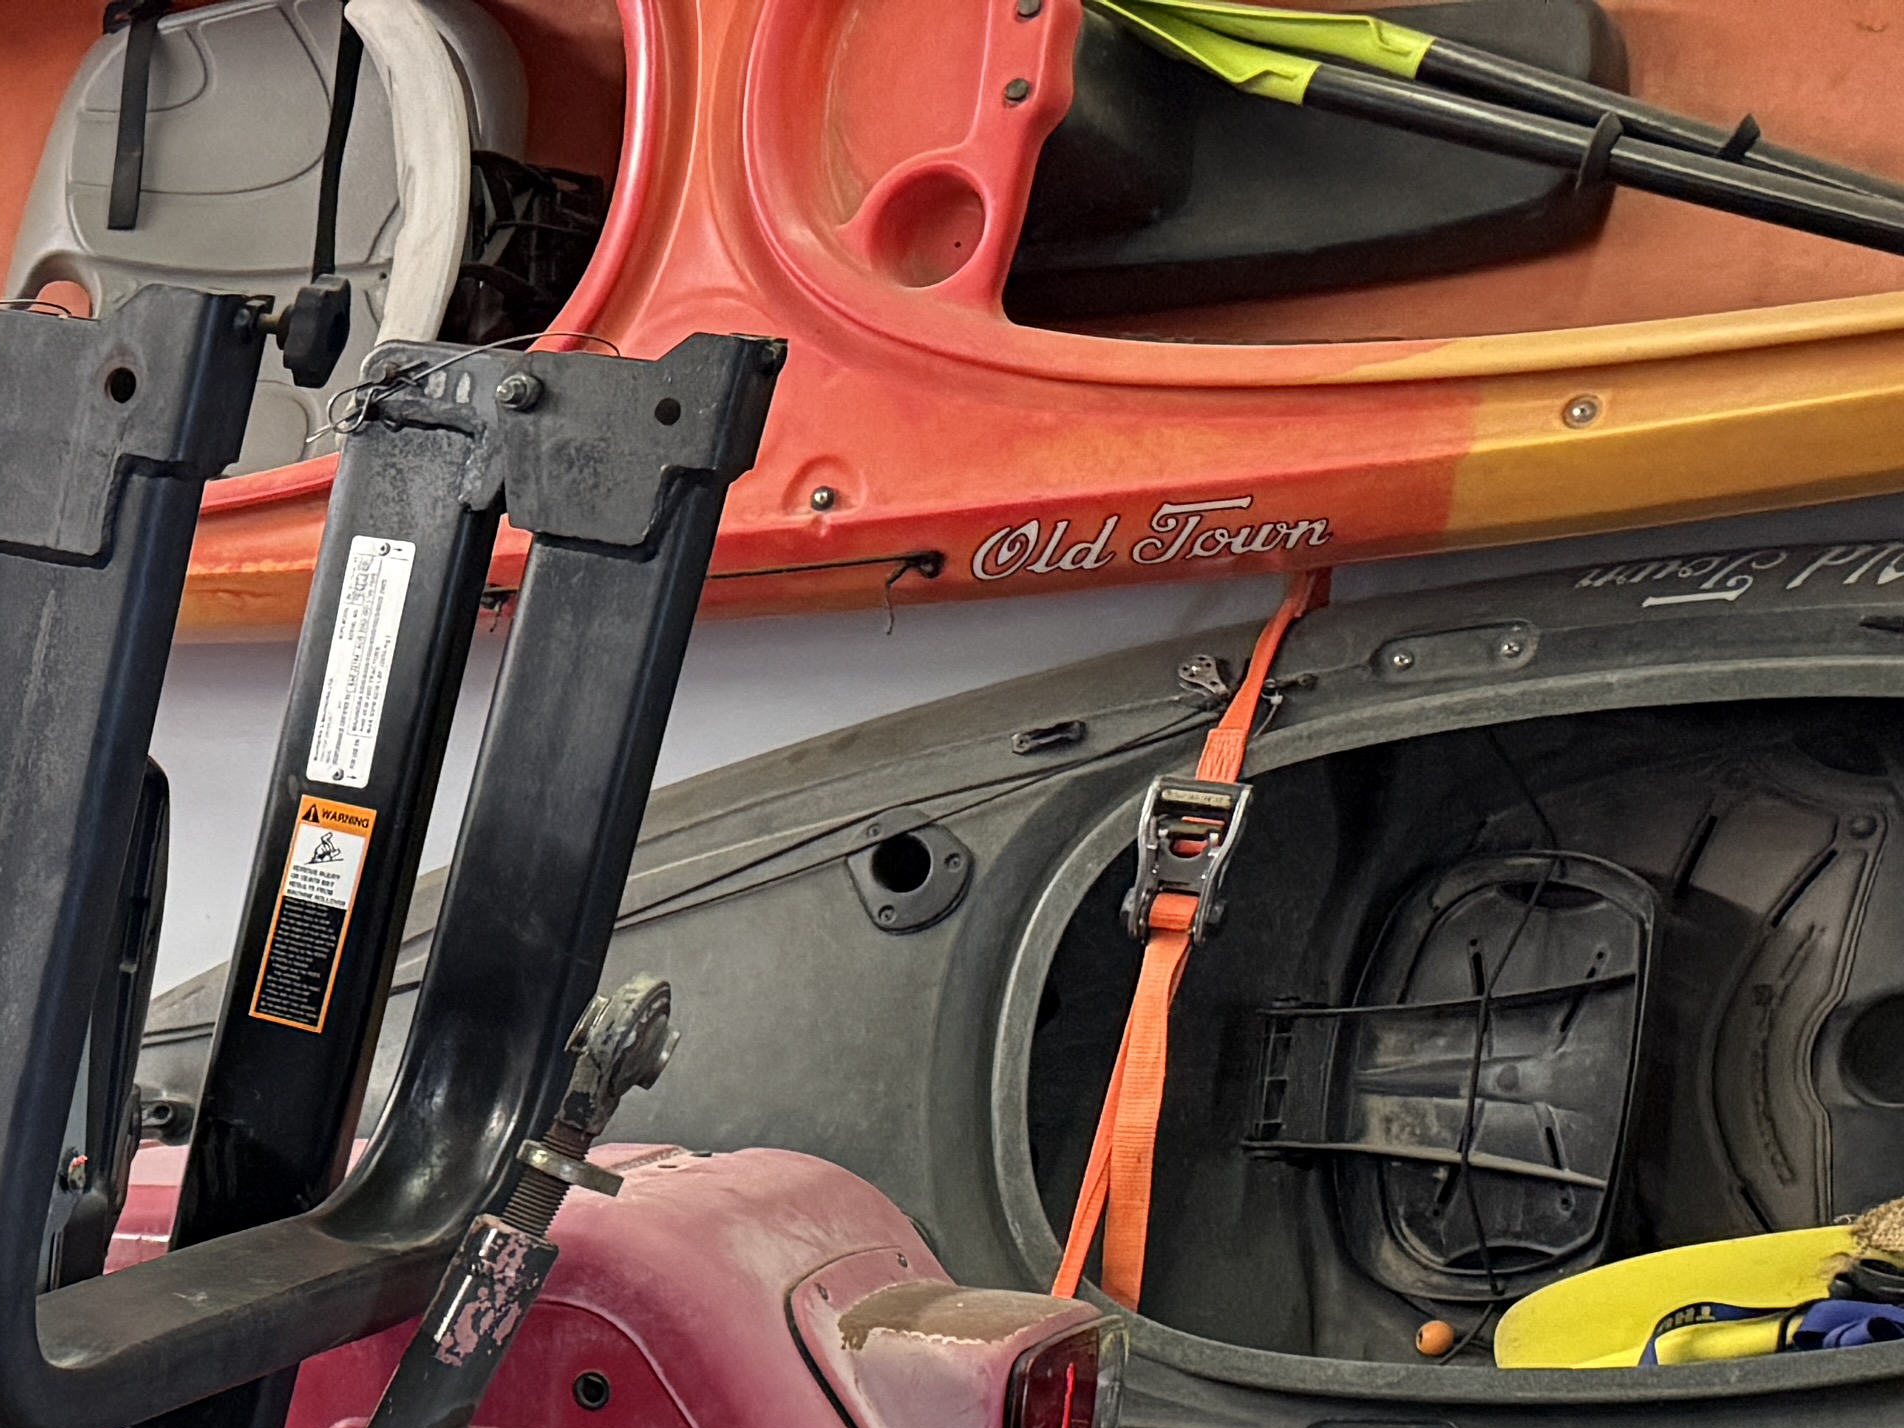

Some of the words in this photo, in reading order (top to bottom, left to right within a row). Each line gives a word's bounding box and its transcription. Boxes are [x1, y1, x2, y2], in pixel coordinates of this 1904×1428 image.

[970, 515, 1120, 582] Old
[1132, 496, 1334, 565] Town
[321, 807, 370, 829] WARNING
